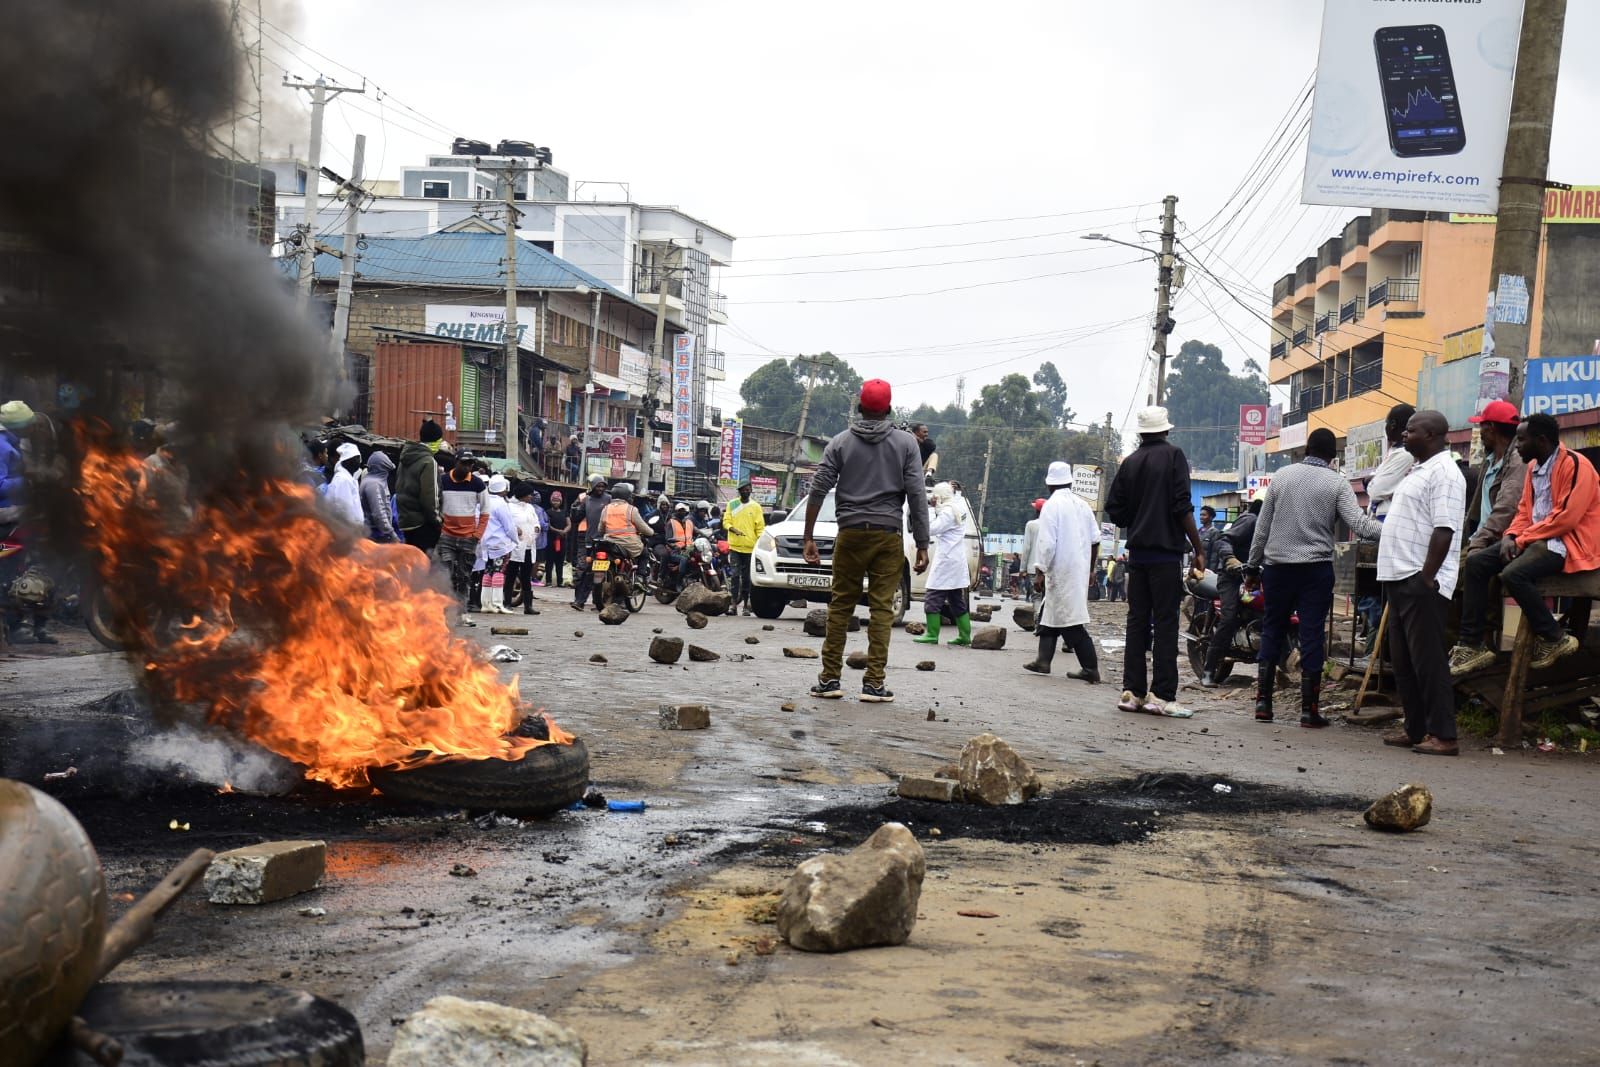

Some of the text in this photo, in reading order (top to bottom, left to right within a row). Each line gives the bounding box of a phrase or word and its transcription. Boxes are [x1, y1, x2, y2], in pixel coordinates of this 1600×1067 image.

[1331, 168, 1480, 186] www.empirefx.com
[435, 322, 529, 344] CHEMIT
[1521, 393, 1600, 418] UPERM
[1072, 486, 1099, 494] SPACES
[1075, 479, 1097, 487] THESE
